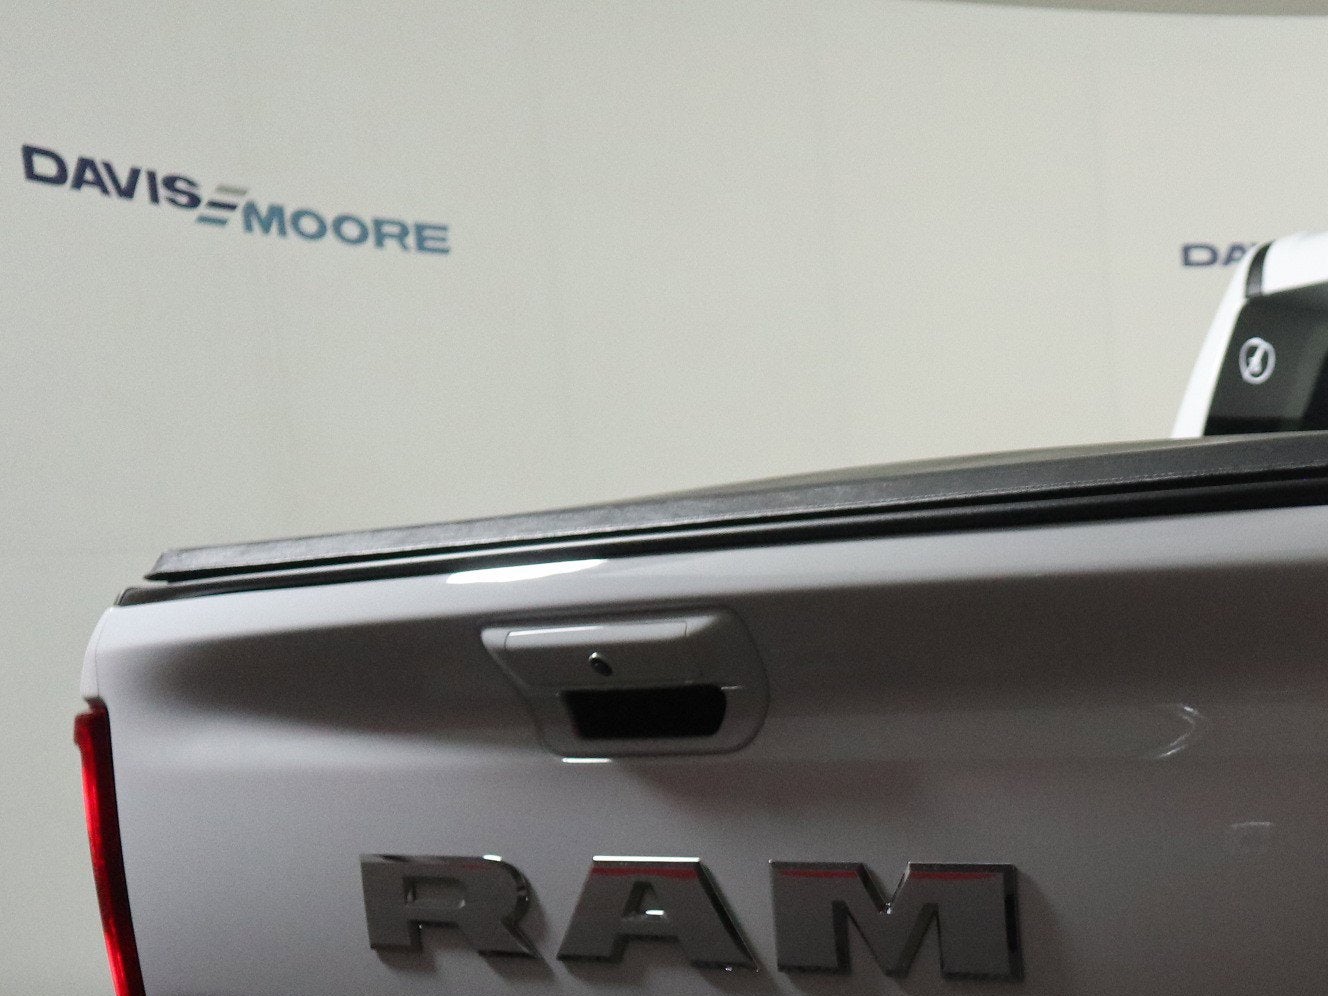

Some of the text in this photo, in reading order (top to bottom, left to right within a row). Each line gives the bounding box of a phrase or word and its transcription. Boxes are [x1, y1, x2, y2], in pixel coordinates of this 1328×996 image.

[22, 144, 450, 255] DAVIS MOORE
[360, 854, 1024, 982] RAM
